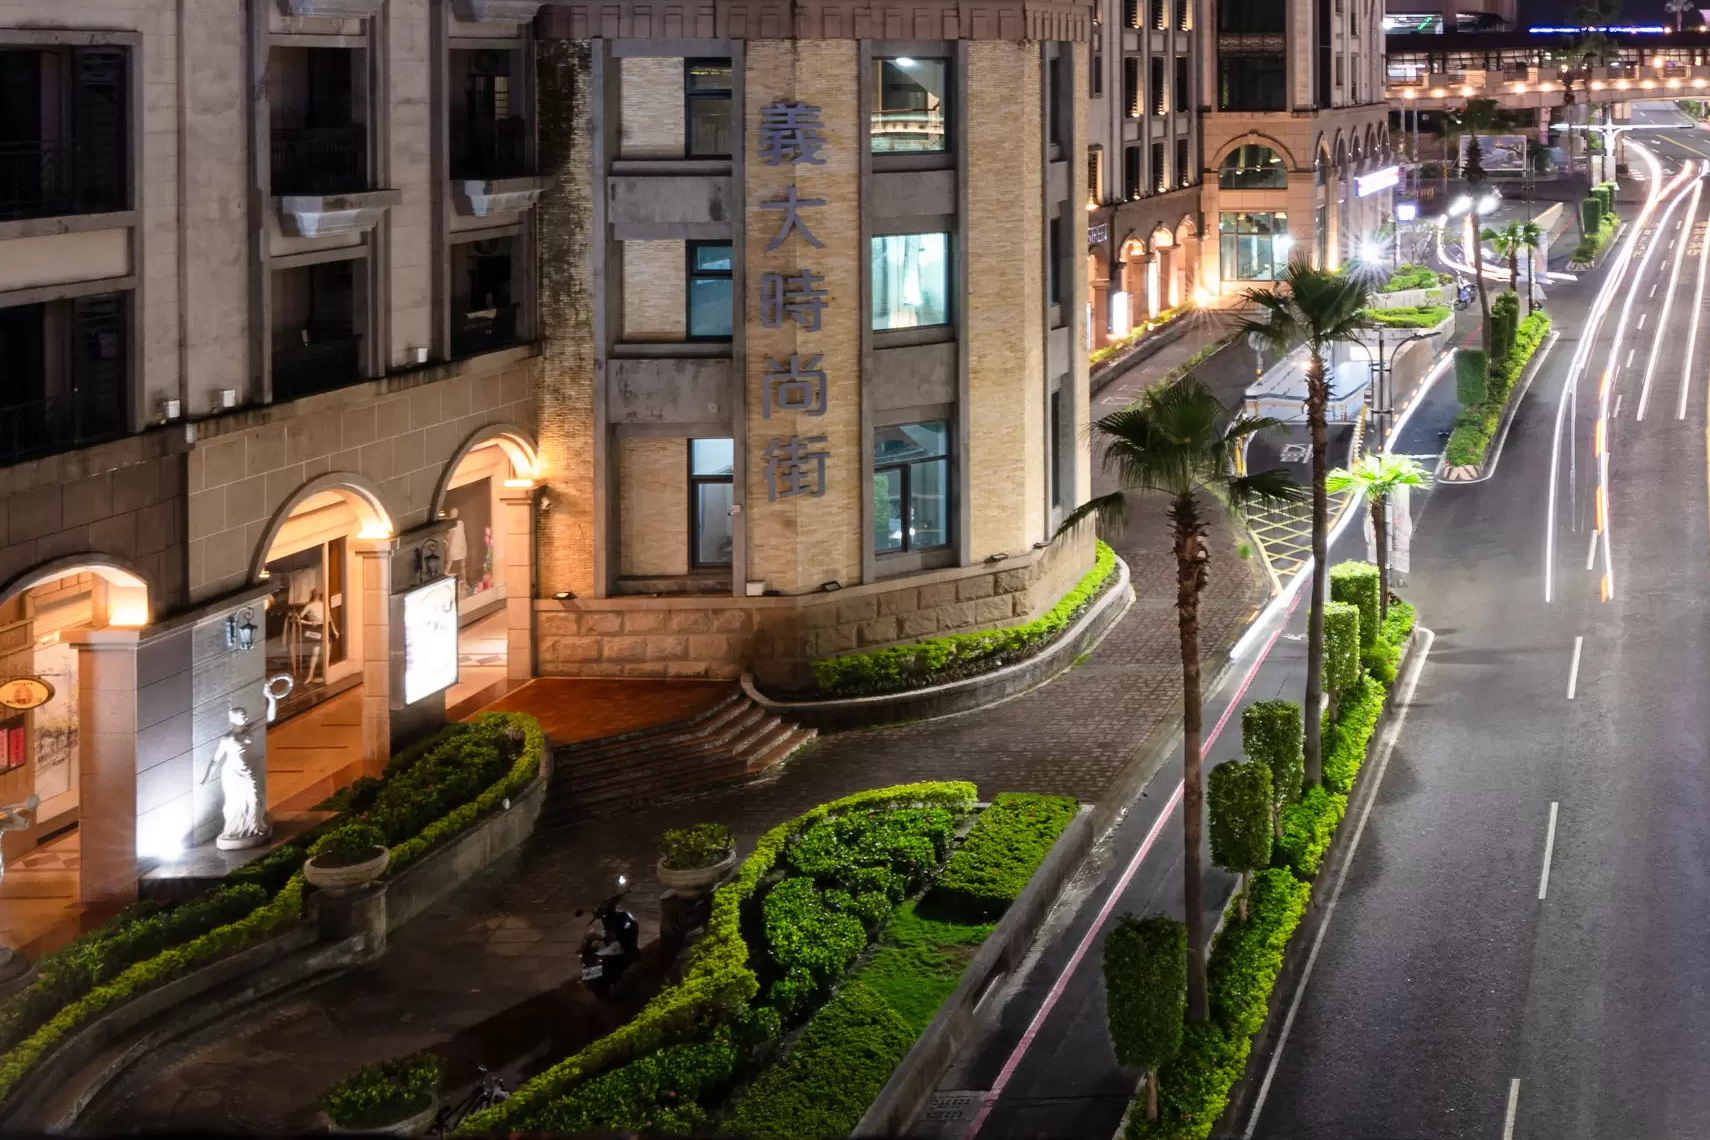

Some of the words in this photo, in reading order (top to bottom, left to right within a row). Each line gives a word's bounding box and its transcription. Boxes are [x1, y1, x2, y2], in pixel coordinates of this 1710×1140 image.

[759, 101, 830, 502] 義大時尚街
